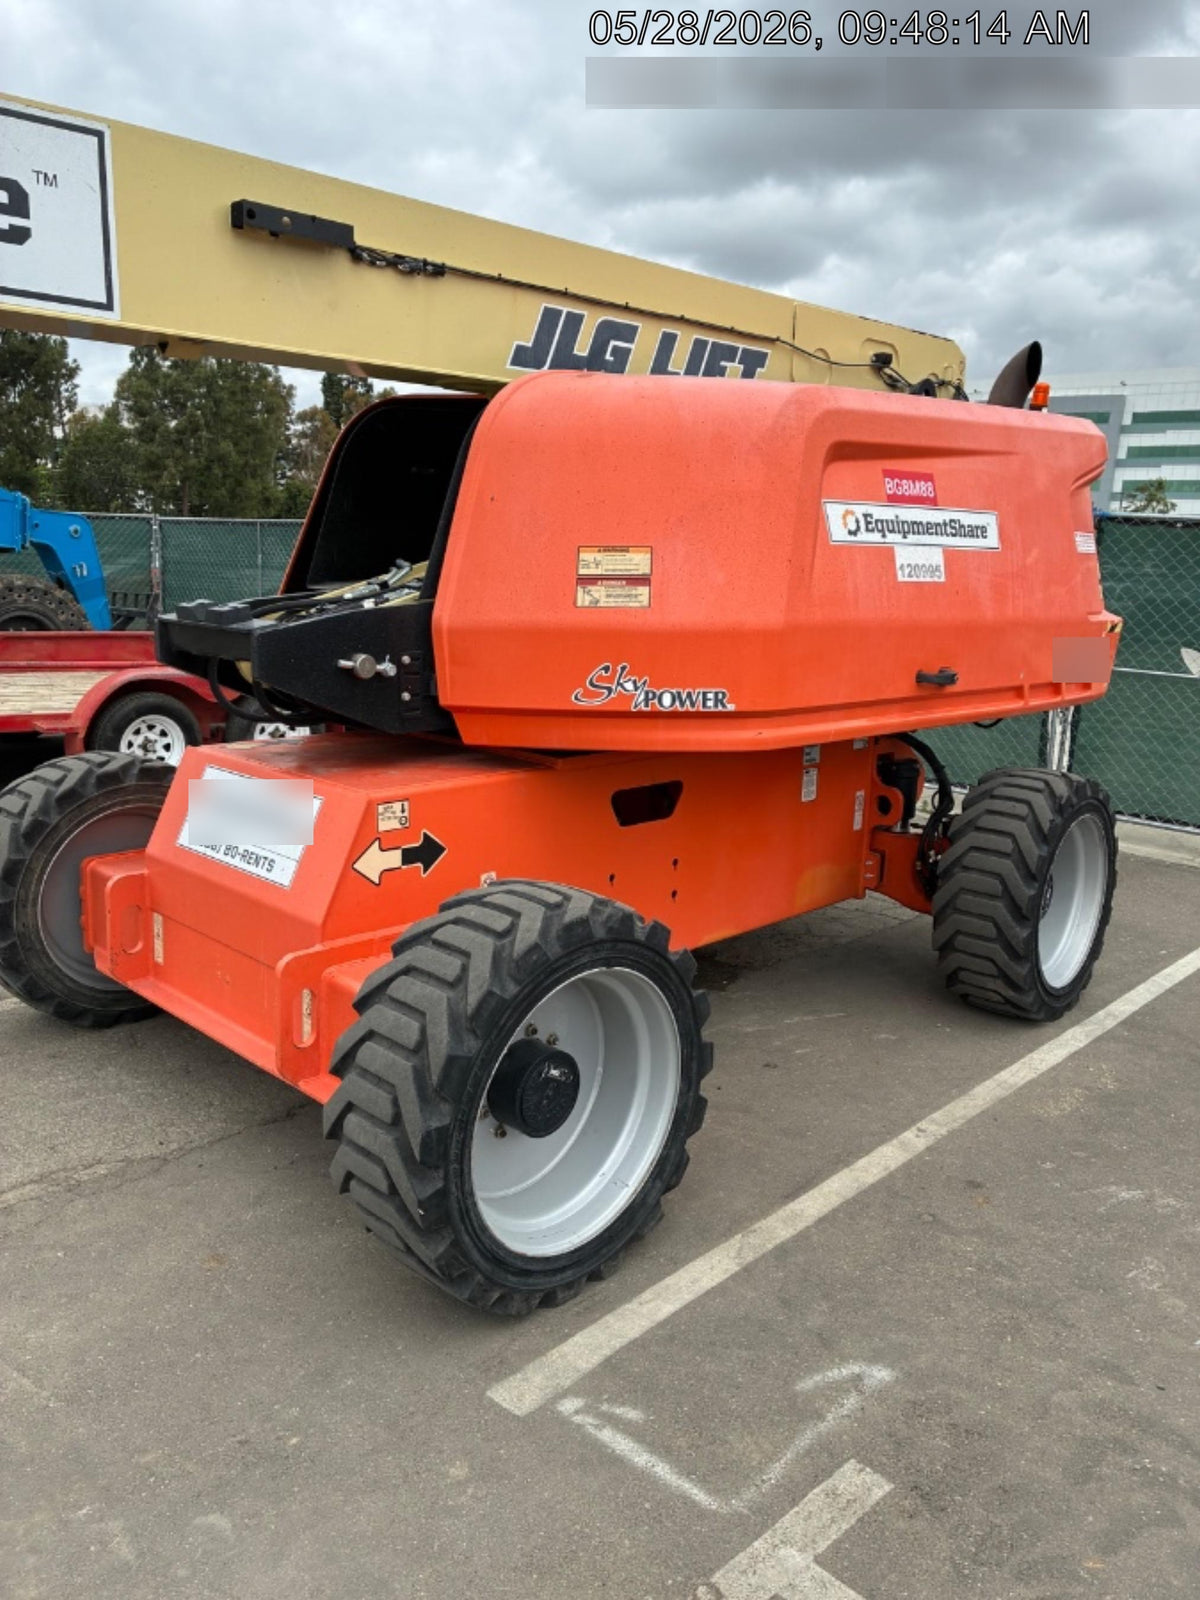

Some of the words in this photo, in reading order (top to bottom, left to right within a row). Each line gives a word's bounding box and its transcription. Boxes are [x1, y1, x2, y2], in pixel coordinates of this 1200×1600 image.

[507, 304, 641, 373] JLG
[650, 329, 771, 379] LIFT
[862, 513, 988, 540] EquipmentShare
